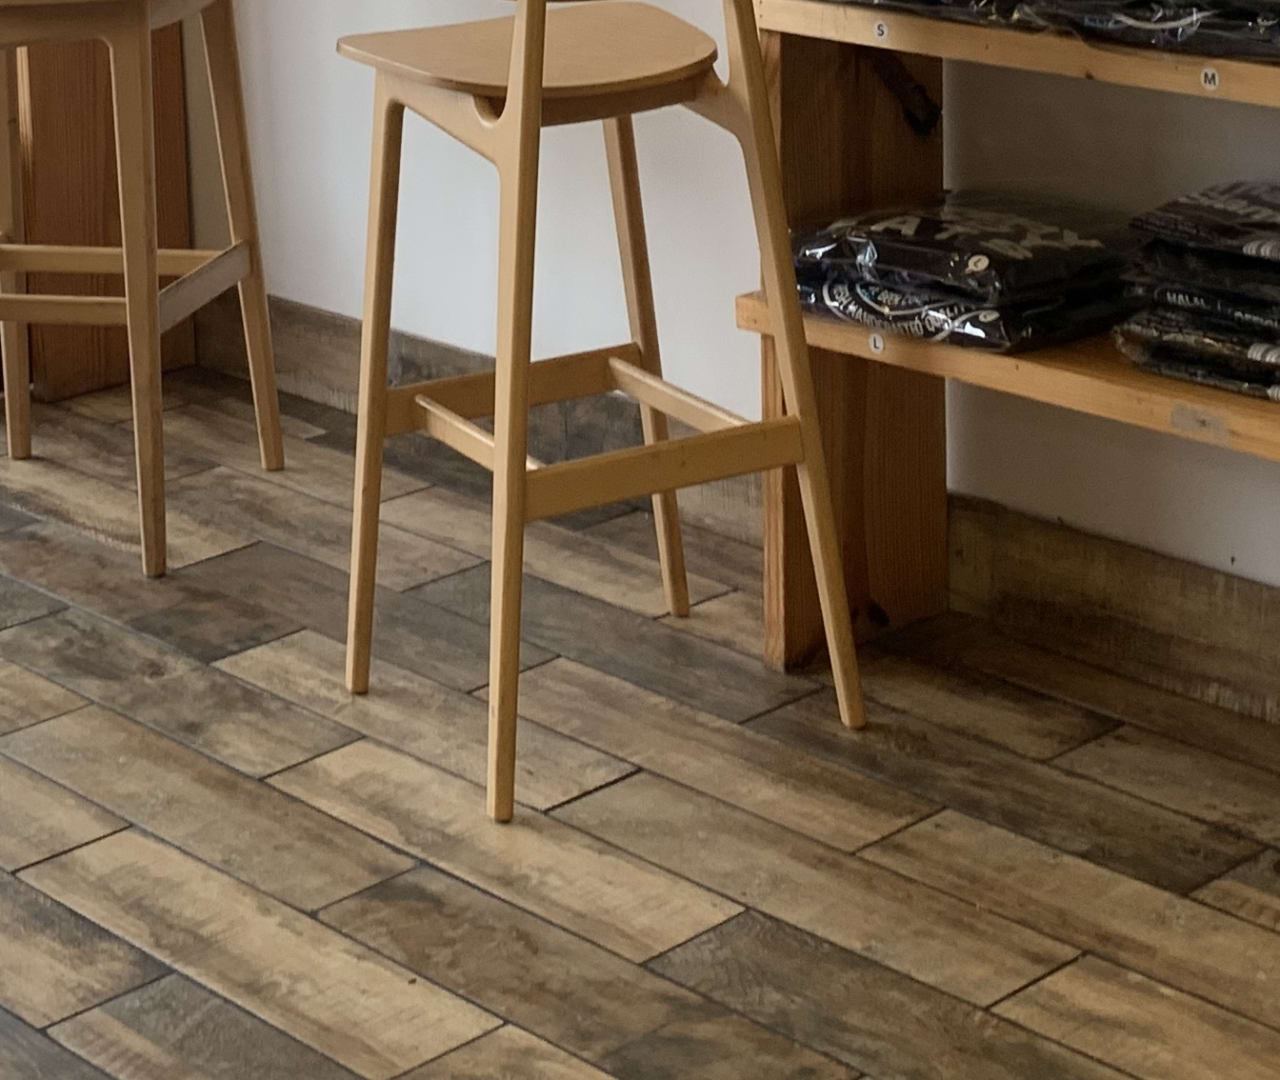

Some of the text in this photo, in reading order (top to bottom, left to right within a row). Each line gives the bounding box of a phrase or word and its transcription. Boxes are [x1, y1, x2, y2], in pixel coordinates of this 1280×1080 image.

[876, 23, 885, 37] S
[1204, 71, 1216, 86] M
[873, 336, 880, 350] L
